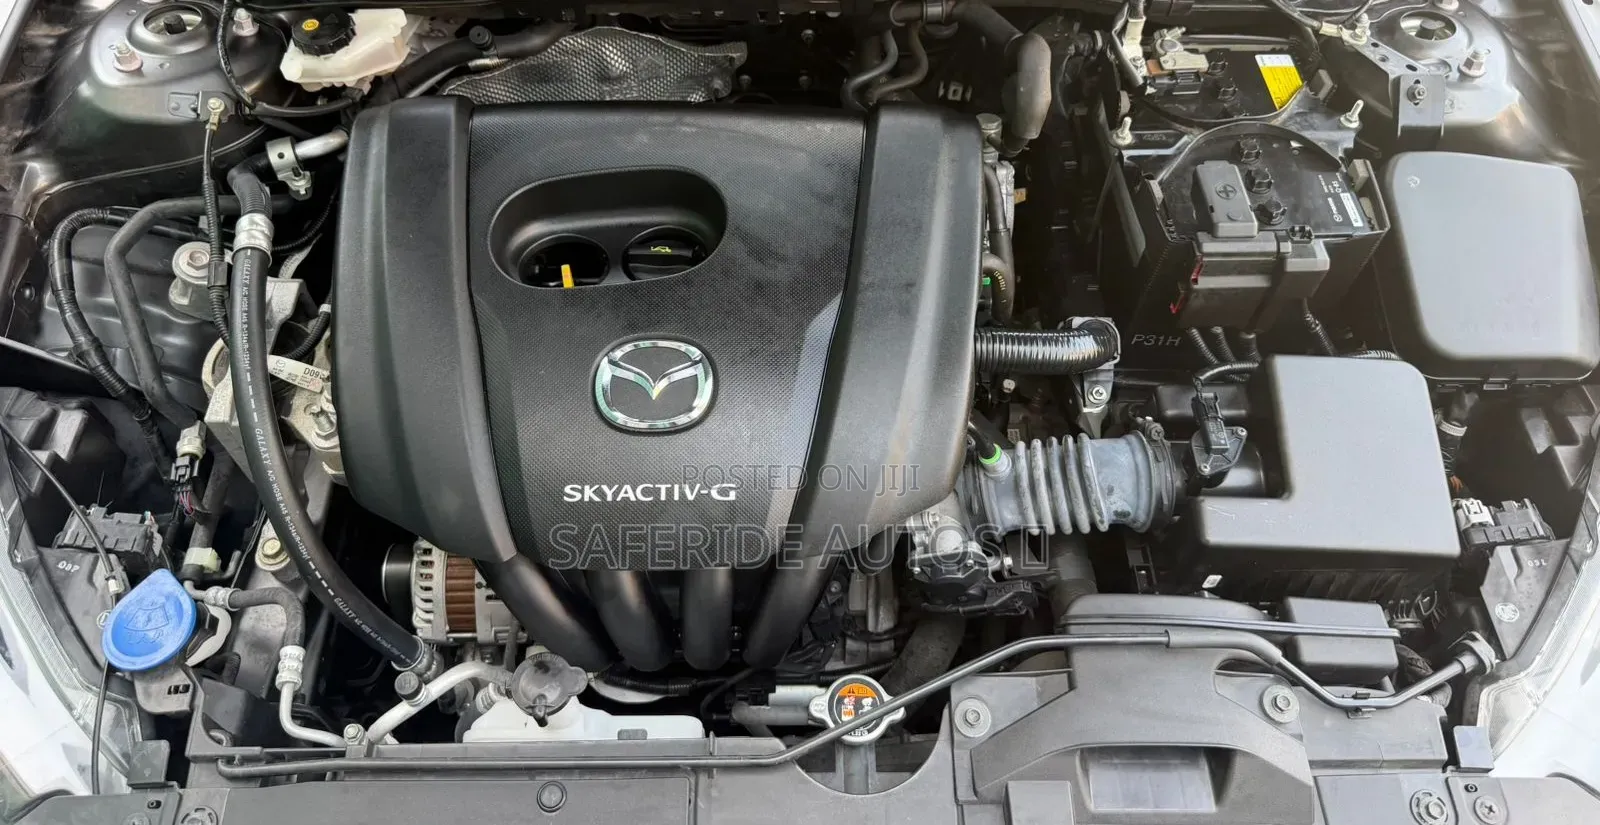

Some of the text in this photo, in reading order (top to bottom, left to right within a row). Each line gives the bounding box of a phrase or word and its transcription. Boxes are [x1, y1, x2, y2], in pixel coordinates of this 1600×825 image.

[1131, 334, 1182, 346] P31H
[255, 428, 272, 465] GALAXY
[267, 469, 276, 482] A/C
[272, 483, 283, 501] HOSE
[563, 483, 736, 502] SKYACTIV-G
